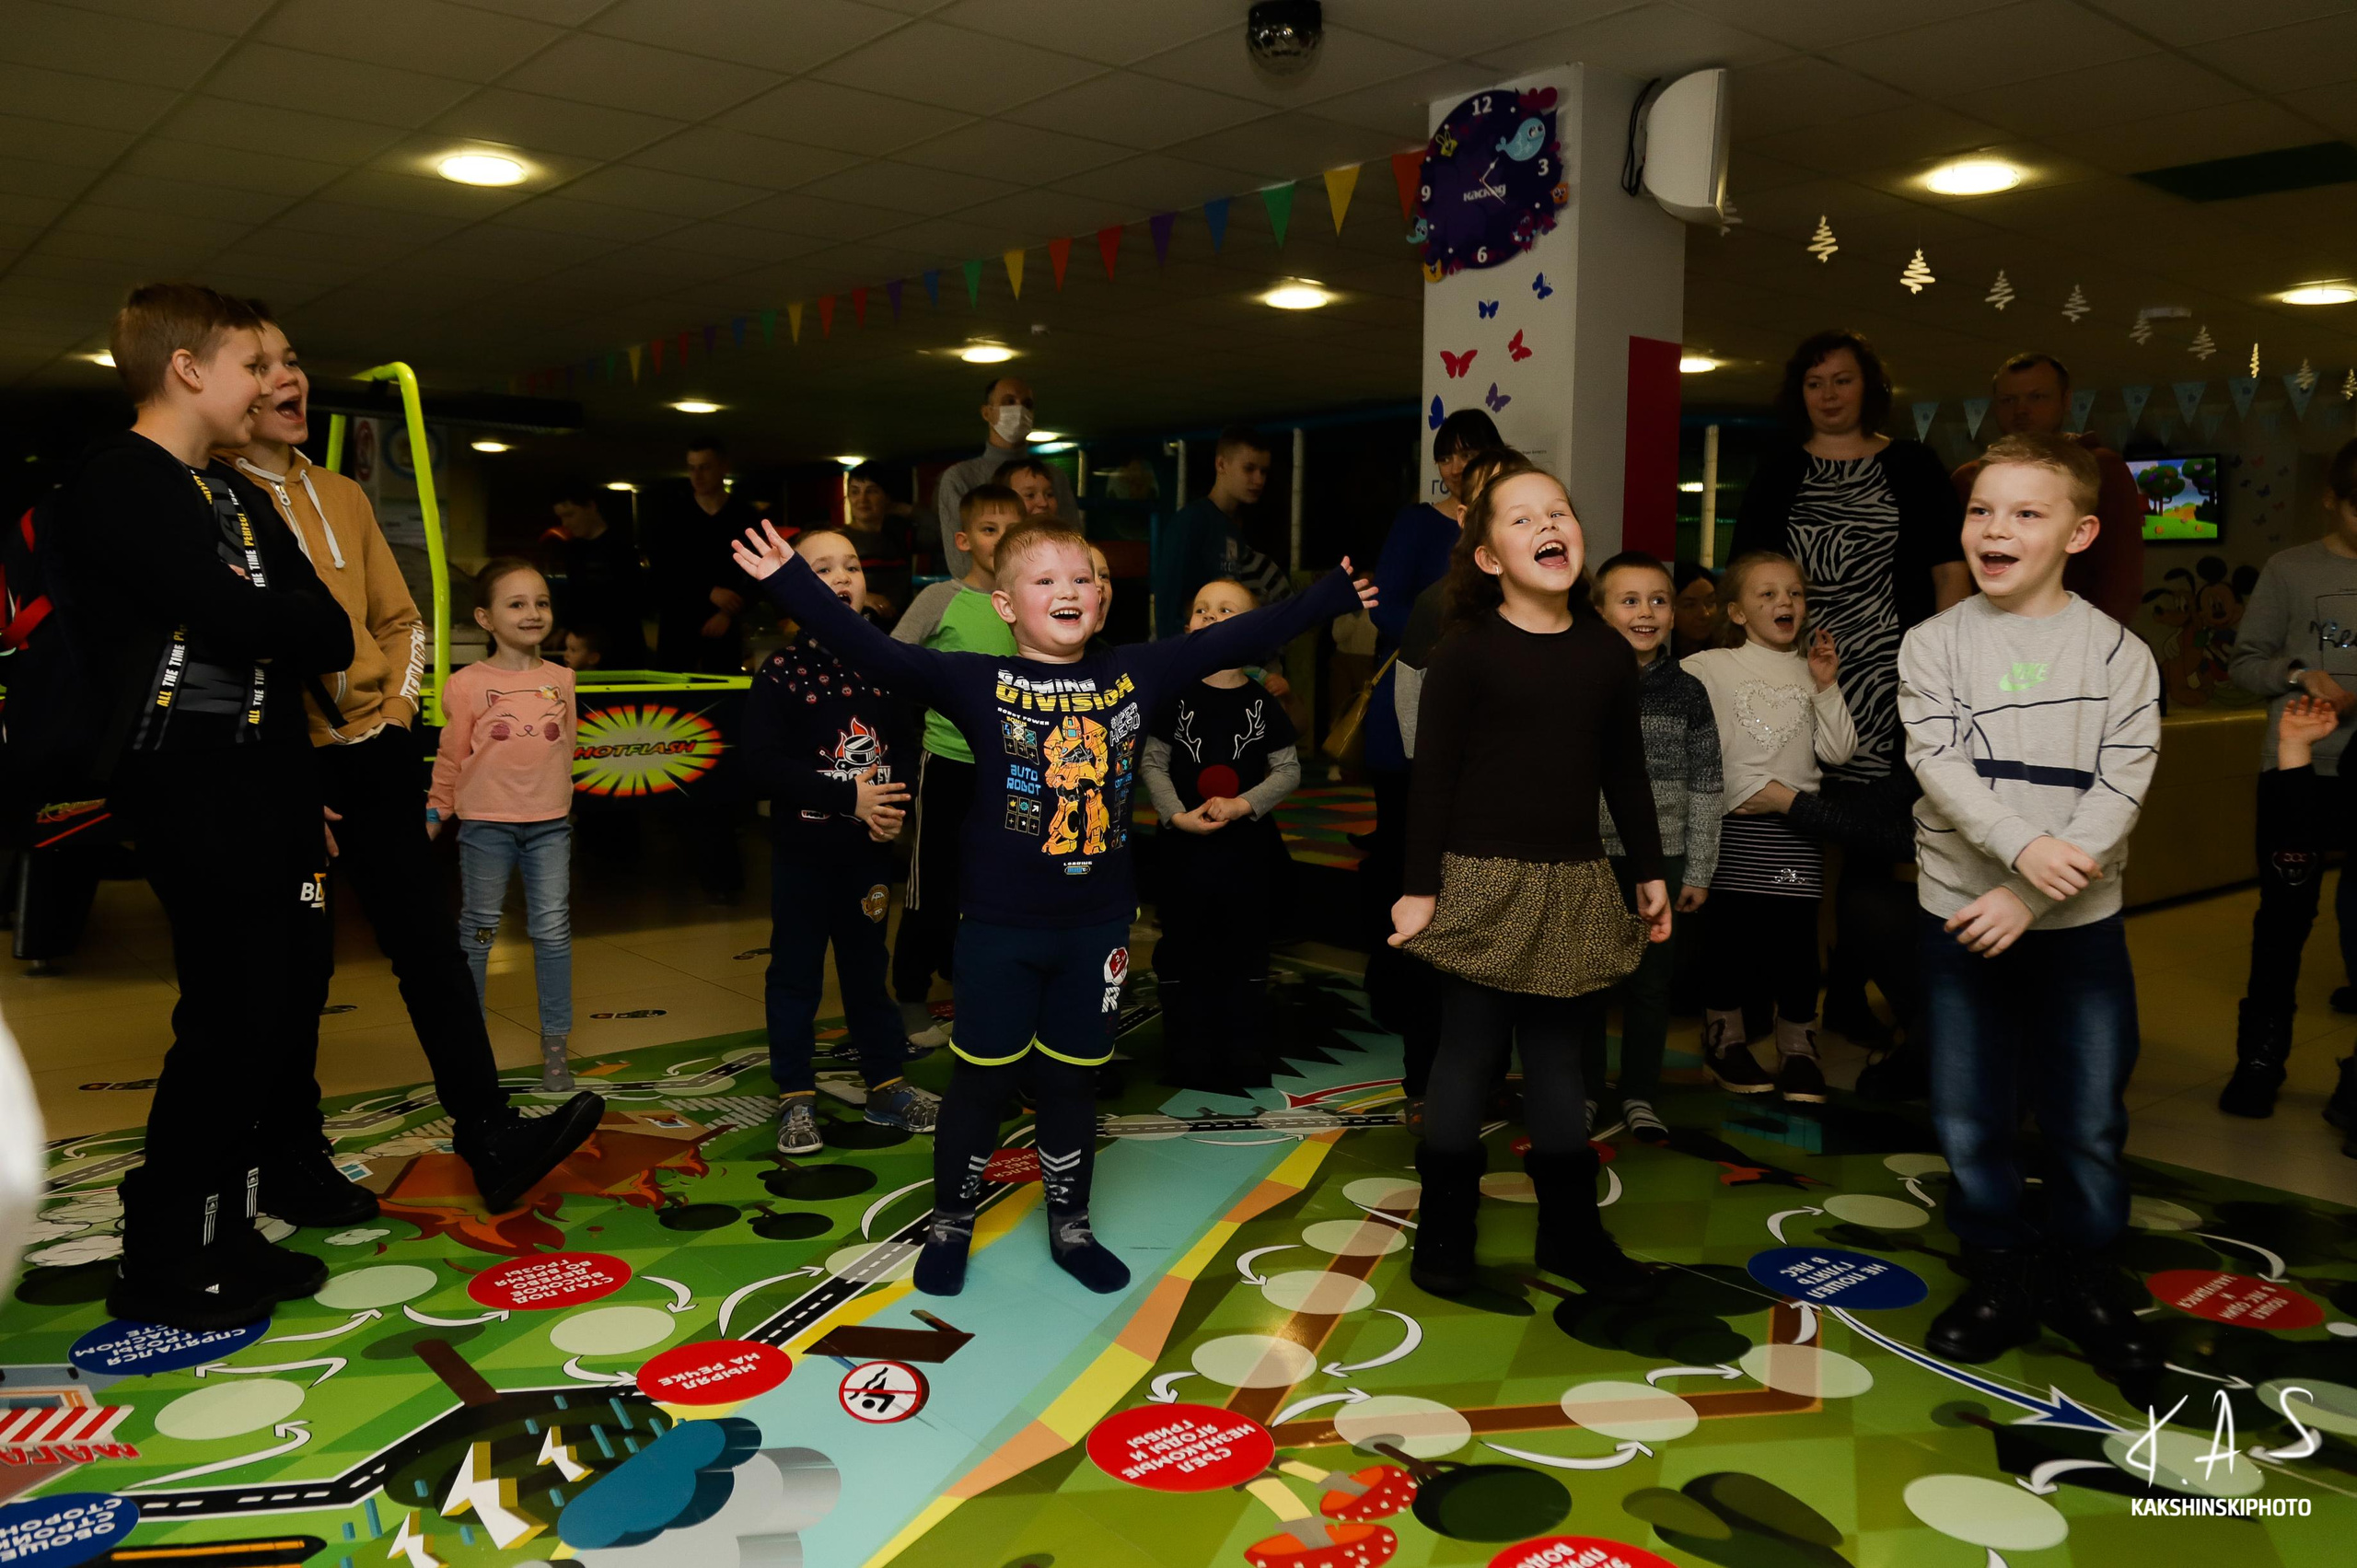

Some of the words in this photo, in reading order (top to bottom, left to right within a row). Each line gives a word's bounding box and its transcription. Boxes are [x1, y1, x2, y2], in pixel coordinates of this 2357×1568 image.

[1472, 95, 1492, 116] 12
[1538, 157, 1550, 177] 3
[1421, 185, 1432, 202] 9
[1477, 246, 1488, 263] 6
[168, 644, 186, 667] TIME
[161, 668, 180, 687] THE
[997, 668, 1097, 694] GAMING
[156, 690, 173, 708] ALL
[252, 689, 265, 706] THE
[995, 672, 1135, 713] DIVISION
[247, 709, 261, 726] ALL
[1022, 715, 1051, 726] POWER
[1109, 713, 1141, 747] HERO
[573, 739, 697, 760] HOTFLASH
[1010, 763, 1039, 782] AUTO
[1006, 777, 1041, 796] ROBOT
[504, 1259, 569, 1277] ГРОЗЫ
[565, 1260, 592, 1271] ВО
[1779, 1260, 1816, 1278] ЛЕС
[1810, 1256, 1830, 1265] В
[1860, 1263, 1889, 1276] НЕ
[493, 1268, 561, 1287] ВРЕМЯ
[512, 1267, 588, 1290] ДЕРЕВО
[1796, 1260, 1857, 1285] ГУЛЯТЬ
[510, 1271, 605, 1298] ВЫСОКОЕ
[563, 1276, 615, 1293] СТАЛ
[1805, 1271, 1869, 1299] ПОШЕЛ
[512, 1290, 559, 1305] ПОД
[106, 1328, 247, 1366] СПРЯТАЛСЯ
[112, 1331, 193, 1356] ГРОЗЫ
[728, 1352, 761, 1365] НА
[657, 1362, 726, 1387] РЕЧКЕ
[681, 1363, 757, 1390] НЫРЯЛ
[1126, 1418, 1196, 1449] ГРИБЫ
[1148, 1423, 1219, 1455] ЯГОДЫ
[1120, 1423, 1257, 1480] НЕЗНАКОМЫЕ
[1129, 1449, 1149, 1462] И
[1176, 1446, 1233, 1473] СЪЕЛ
